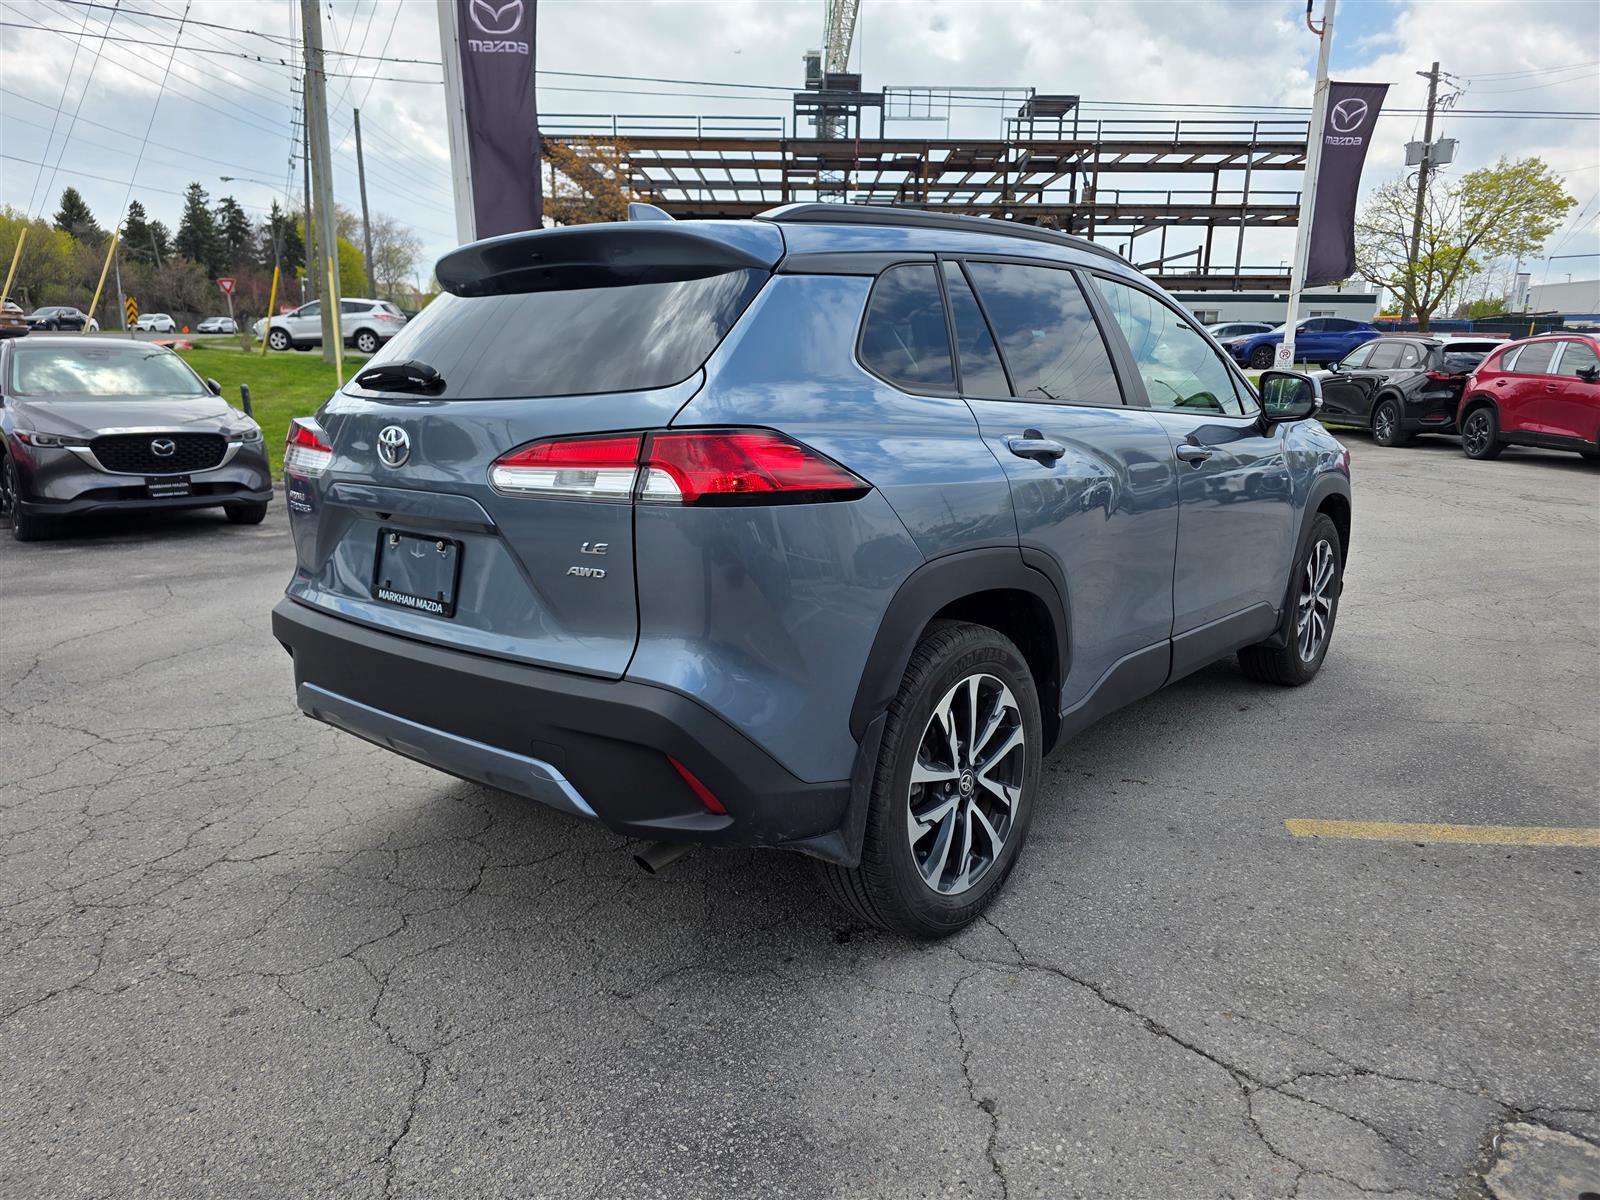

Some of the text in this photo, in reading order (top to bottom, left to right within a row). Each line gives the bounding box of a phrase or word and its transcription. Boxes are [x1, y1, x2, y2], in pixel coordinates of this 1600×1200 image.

[468, 39, 529, 55] mazda
[580, 542, 609, 555] LE
[566, 566, 606, 578] AWD
[378, 588, 443, 614] MARKHAM MAZDA
